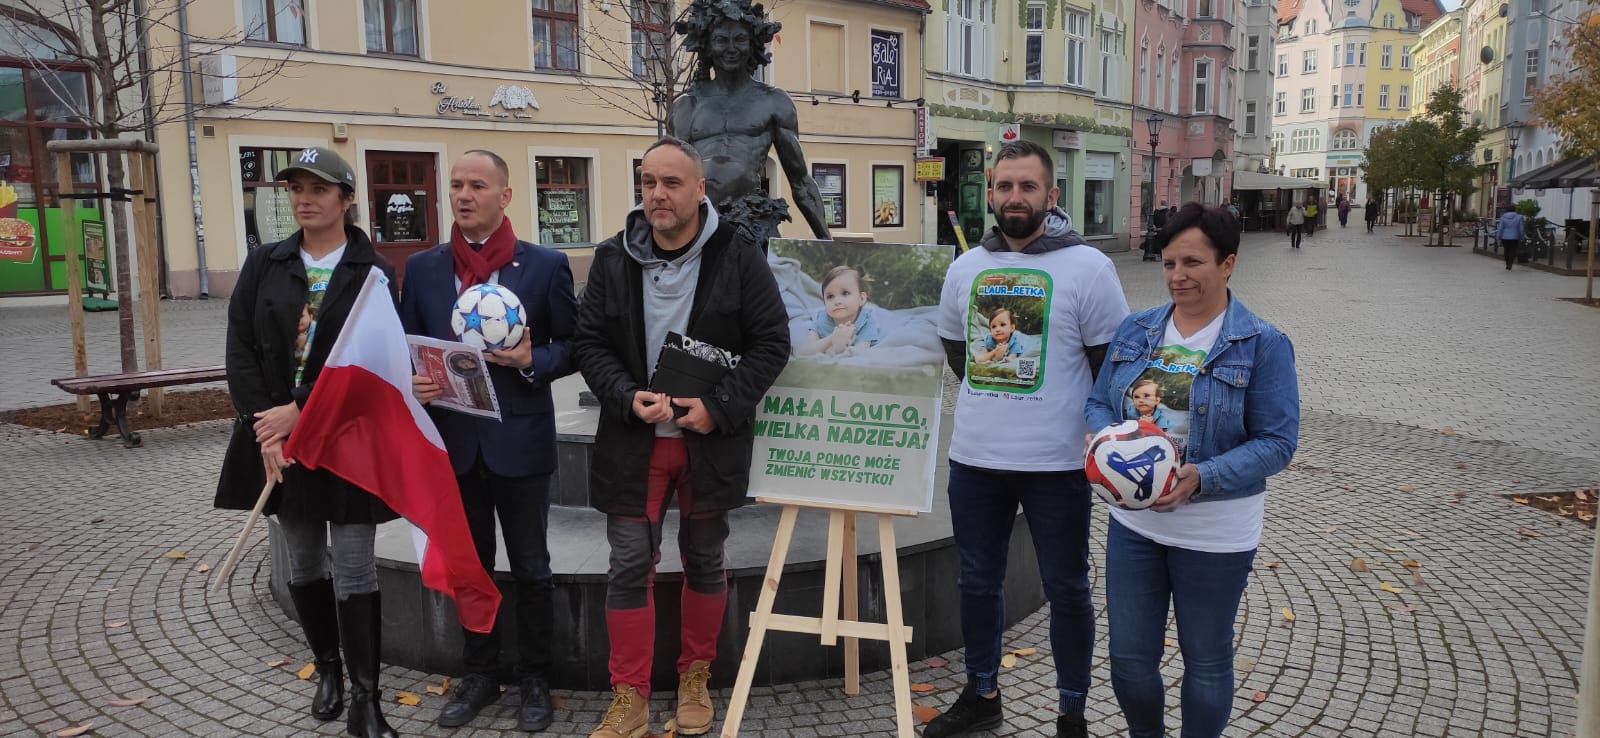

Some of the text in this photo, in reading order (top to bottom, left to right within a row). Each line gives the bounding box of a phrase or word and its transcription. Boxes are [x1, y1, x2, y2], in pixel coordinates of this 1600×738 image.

[763, 395, 928, 427] MAŁA Laura,
[754, 420, 930, 450] WIELKA NADZIEJA!
[768, 447, 900, 470] TWOJA POMOC MOŻE
[765, 464, 895, 486] ZMIENIĆ WSZYSTKO!
